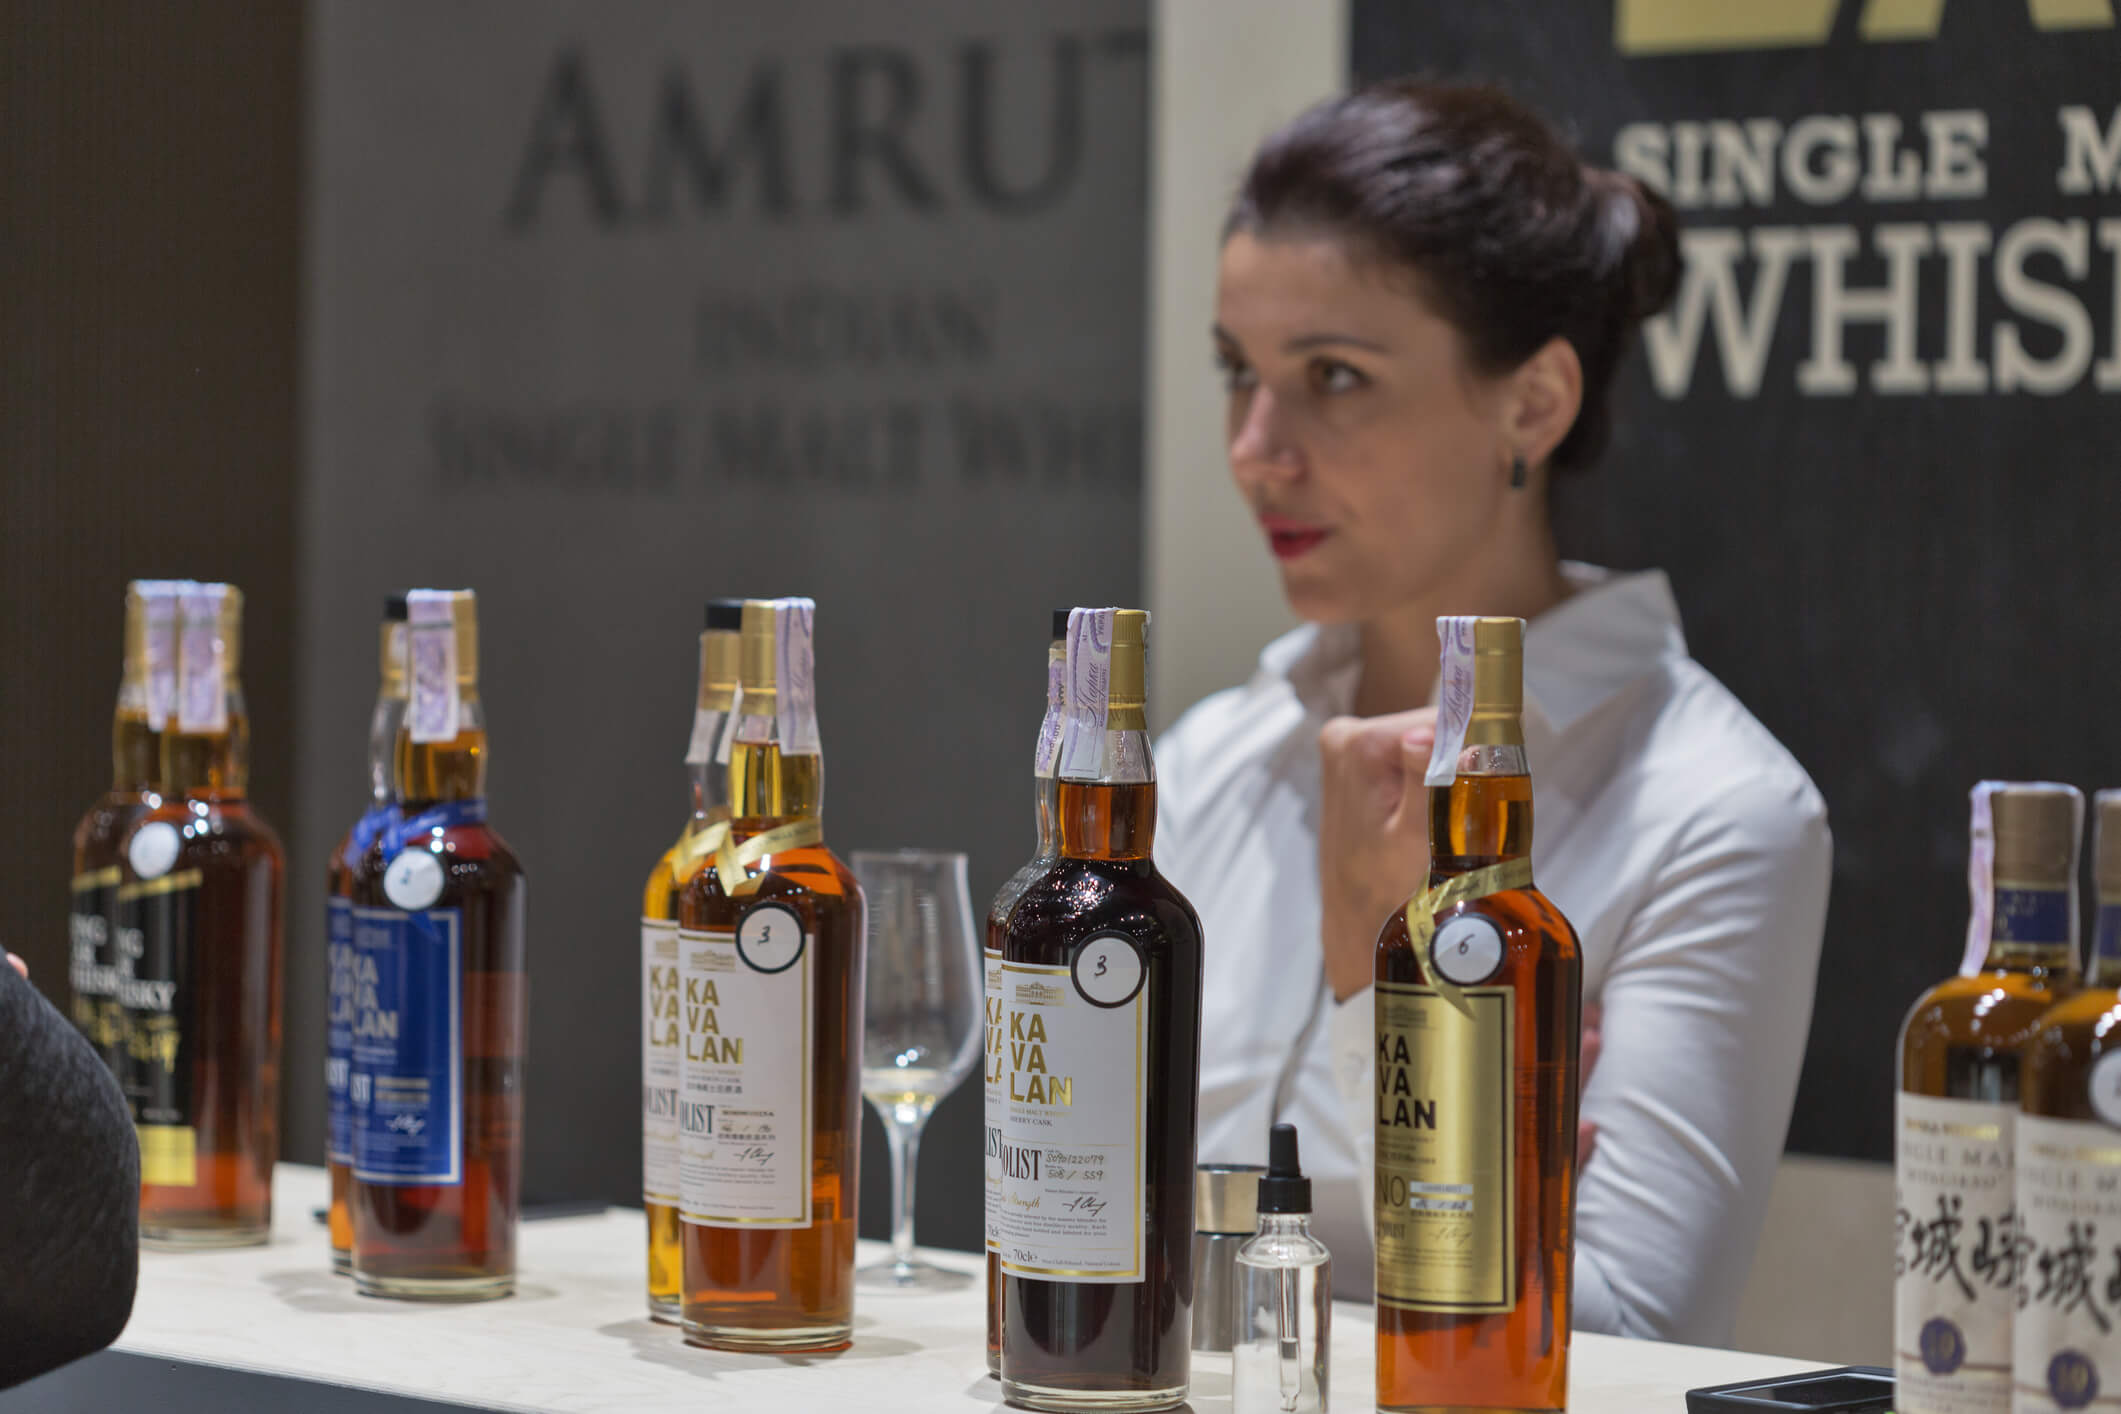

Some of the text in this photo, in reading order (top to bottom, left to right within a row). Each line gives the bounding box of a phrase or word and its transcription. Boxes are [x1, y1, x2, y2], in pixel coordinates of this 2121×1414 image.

[1613, 110, 1988, 208] SINGLE
[757, 925, 770, 944] 3
[1458, 934, 1475, 955] 6
[1094, 955, 1108, 977] 3
[686, 977, 720, 1007] KA
[686, 1006, 720, 1035] VA
[1010, 1011, 1047, 1043] KA
[686, 1034, 743, 1065] LAN
[1010, 1041, 1047, 1074] VA
[1378, 1032, 1411, 1064] KA
[1010, 1072, 1072, 1106] LAN
[1379, 1065, 1411, 1097] VA
[1379, 1095, 1437, 1130] LAN
